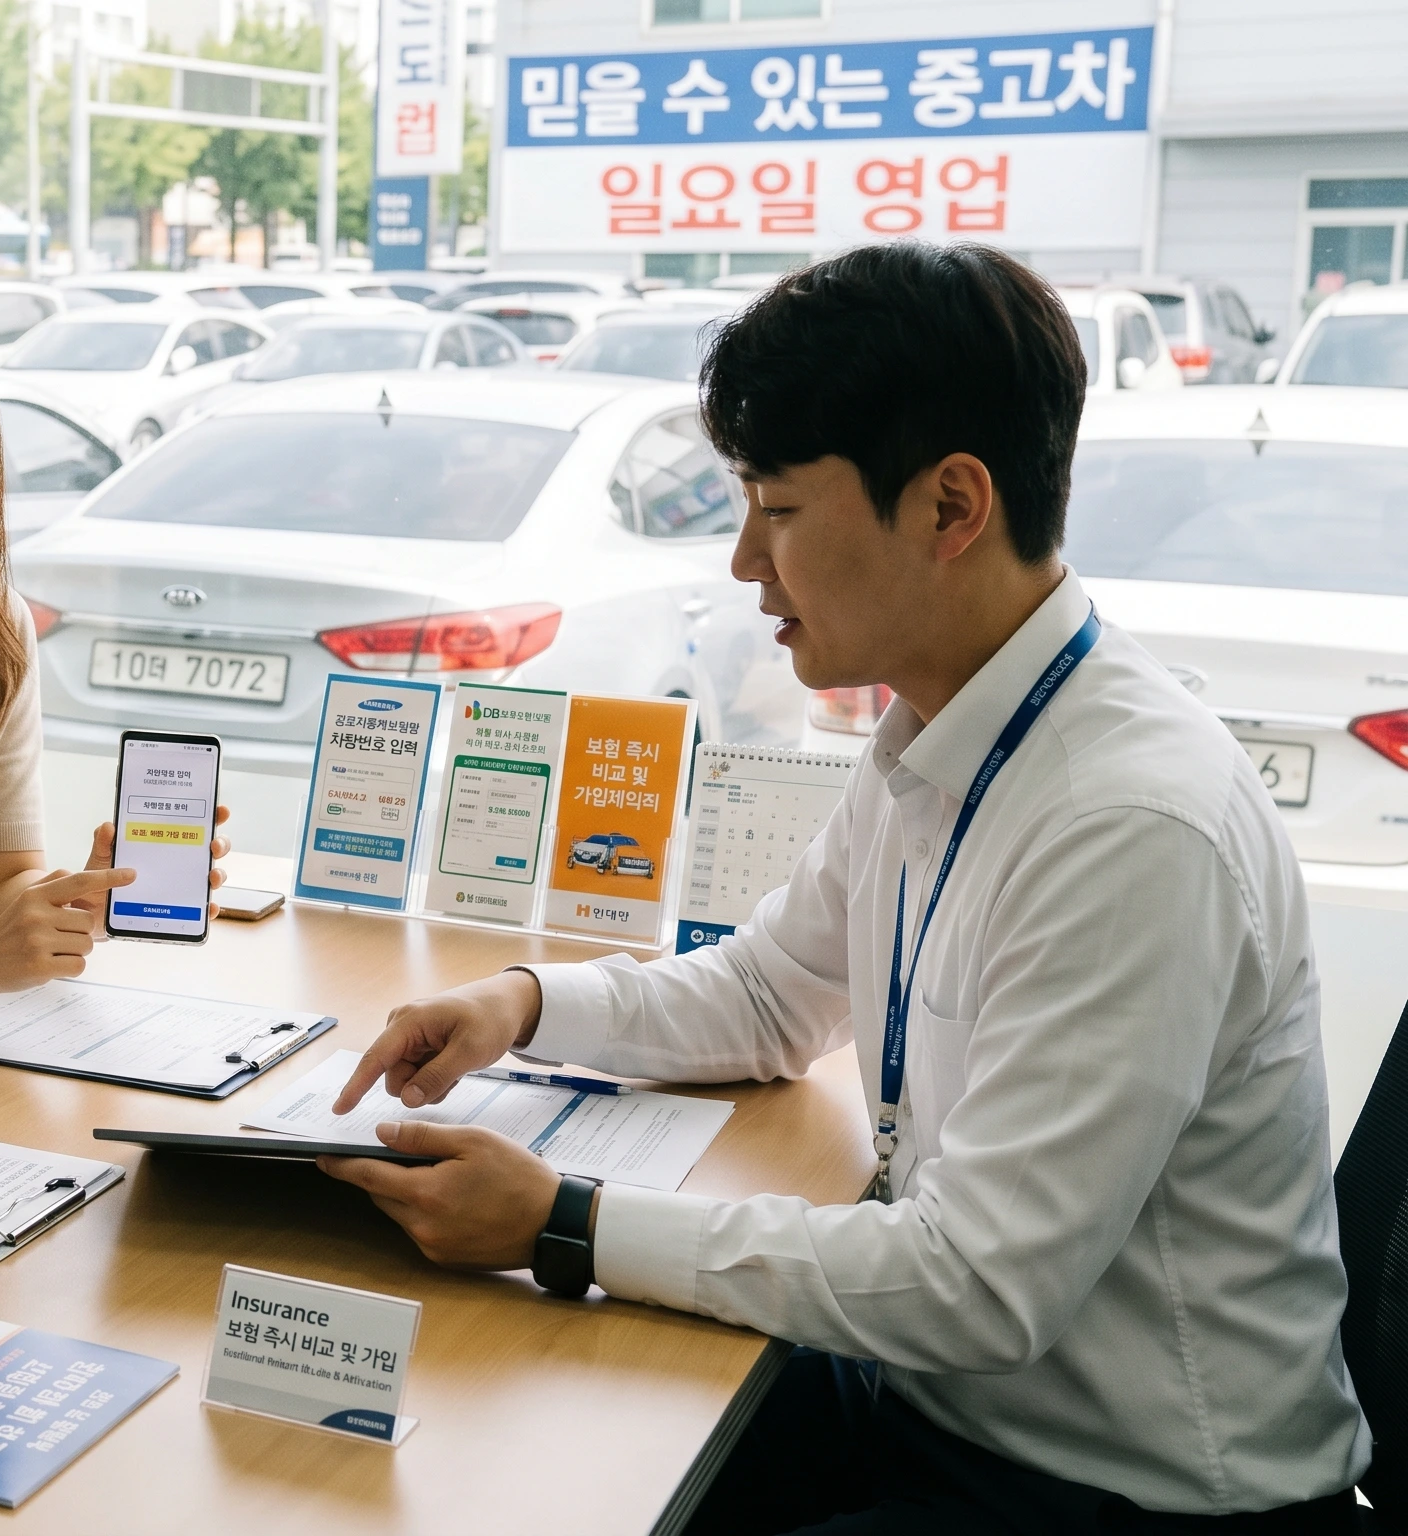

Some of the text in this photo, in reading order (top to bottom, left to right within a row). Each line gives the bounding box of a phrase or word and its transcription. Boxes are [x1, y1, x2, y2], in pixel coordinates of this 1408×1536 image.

[521, 37, 1136, 138] 믿을 수 있는 중고차
[601, 155, 1009, 235] 일요일 영업
[186, 656, 266, 692] 7072
[585, 737, 660, 763] 보험 즉시
[592, 763, 648, 786] 비교 및
[231, 1290, 330, 1328] Insurance
[225, 1319, 260, 1344] 보험
[263, 1325, 297, 1352] 즉시
[300, 1335, 335, 1358] 비교
[340, 1341, 358, 1364] 및
[361, 1347, 397, 1374] 가입
